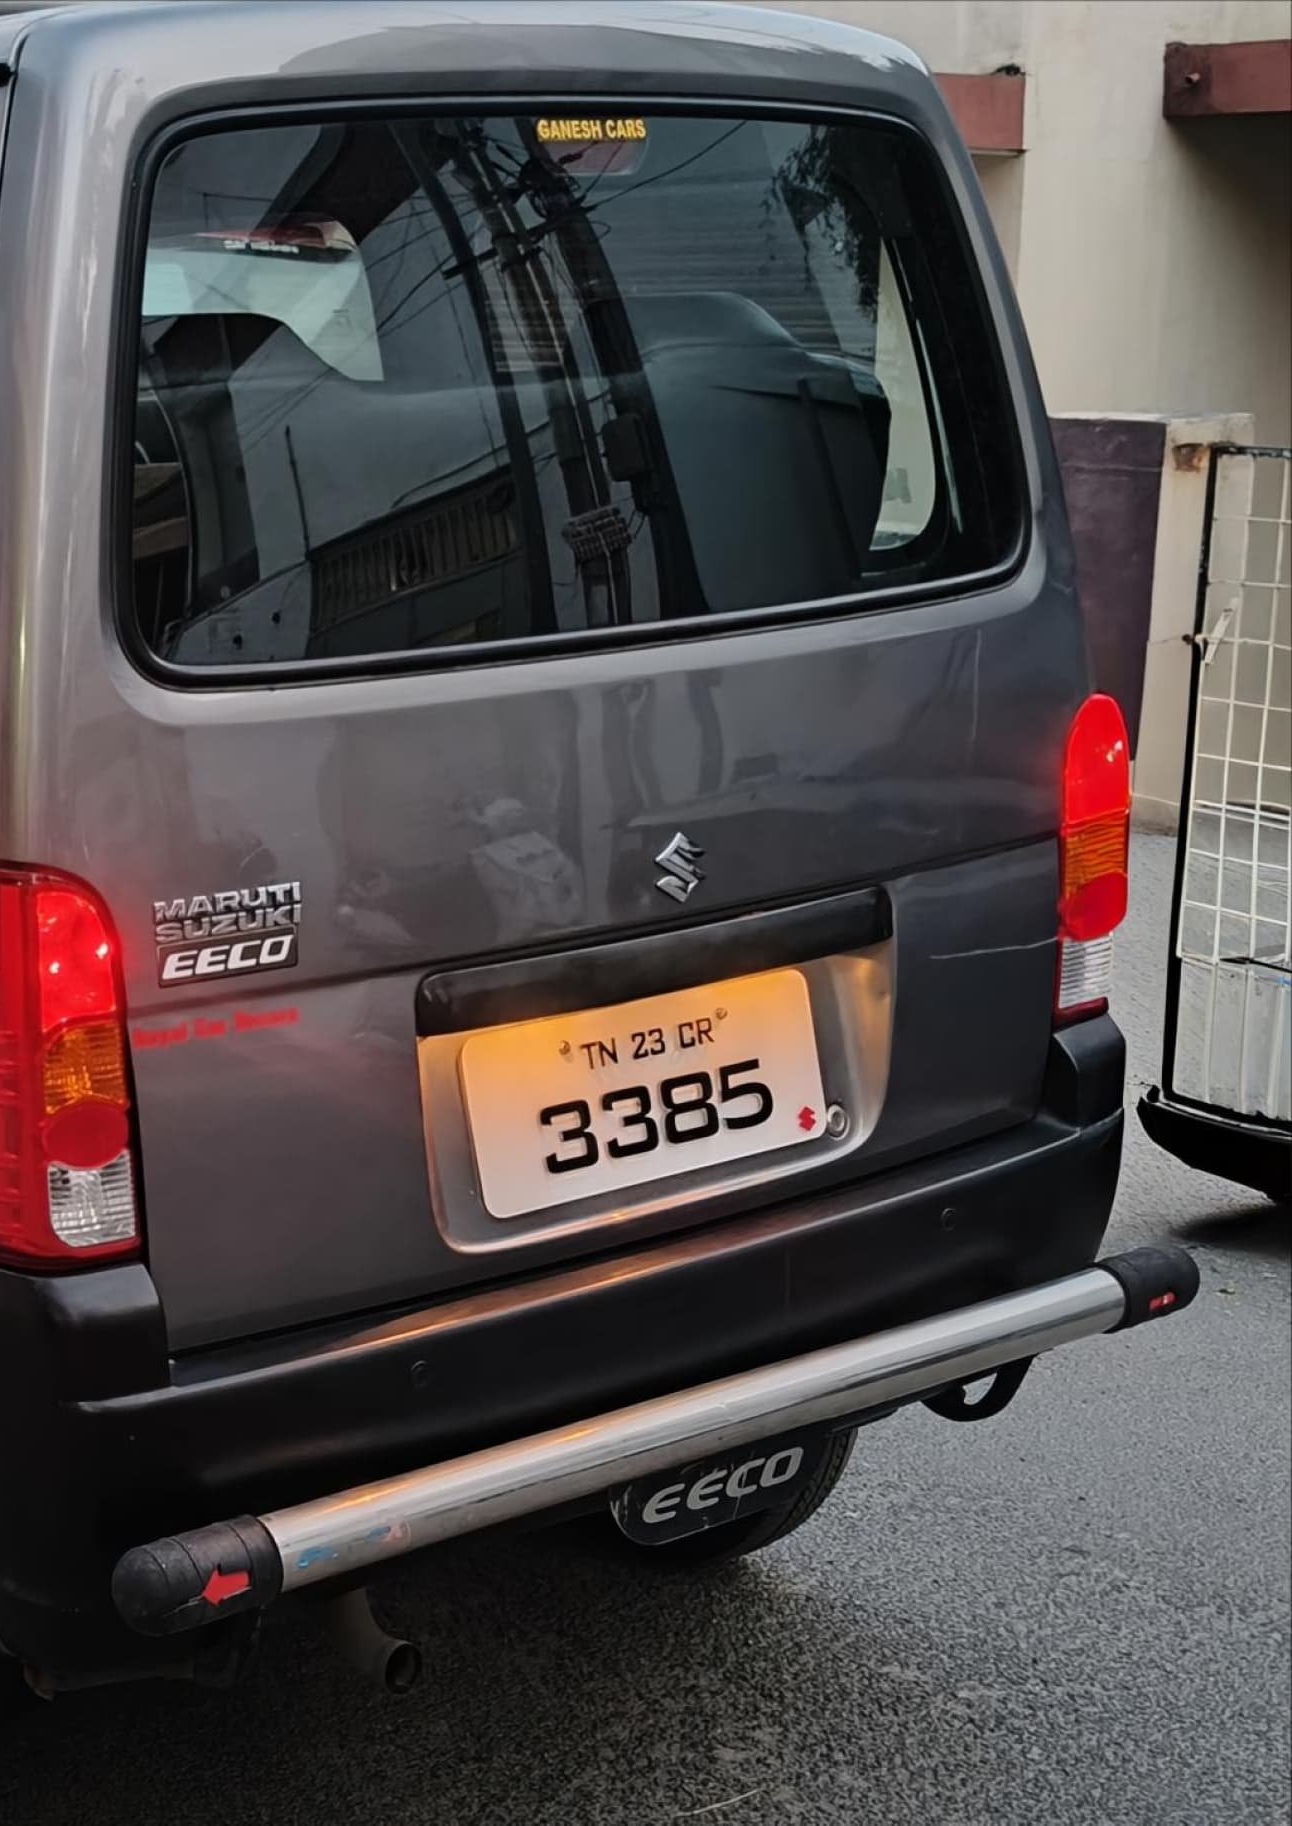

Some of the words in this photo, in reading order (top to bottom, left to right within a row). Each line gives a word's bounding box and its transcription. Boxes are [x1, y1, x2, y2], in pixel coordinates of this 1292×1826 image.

[537, 119, 603, 140] GANESH
[605, 118, 647, 139] CARS
[154, 881, 301, 922] MARUTI
[155, 904, 302, 944] SUZUKI
[161, 934, 295, 980] EECO
[581, 1038, 619, 1070] TN
[631, 1028, 667, 1060] 23
[678, 1017, 715, 1048] CR
[539, 1058, 774, 1175] 3385
[641, 1446, 805, 1524] EECO
